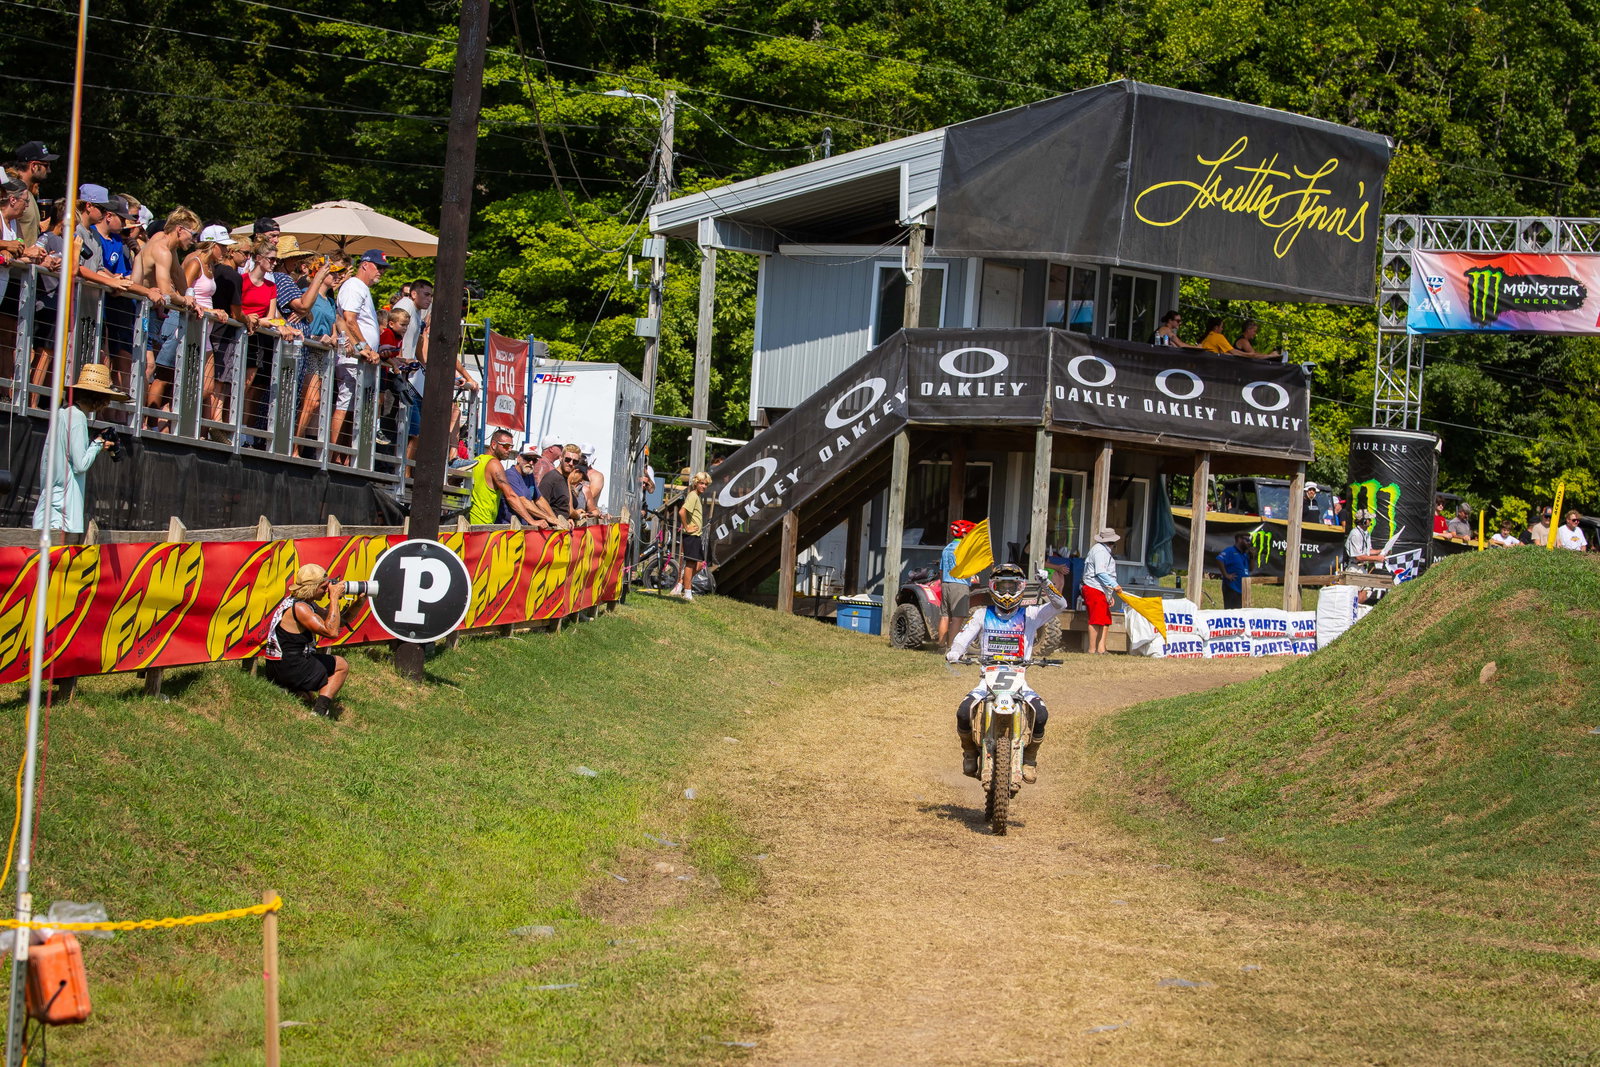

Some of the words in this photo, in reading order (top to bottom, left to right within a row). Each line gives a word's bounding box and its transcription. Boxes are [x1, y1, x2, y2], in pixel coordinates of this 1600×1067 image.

[1134, 136, 1291, 227] Loretta
[1503, 282, 1580, 297] MONSTER
[921, 382, 1026, 396] OAKLEY
[1055, 385, 1128, 409] OAKLEY
[1143, 399, 1216, 421] OAKLEY
[1231, 410, 1302, 432] OAKLEY
[715, 466, 800, 540] OAKLEY
[819, 387, 908, 463] OAKLEY
[1272, 540, 1320, 553] MOTER
[465, 530, 524, 628] FMF
[102, 541, 202, 672] FMF
[207, 539, 295, 661] FMF
[1207, 617, 1245, 630] PARTS
[1249, 618, 1287, 631] PARTS
[1162, 641, 1203, 655] PARTS
[1209, 641, 1251, 653] PARTS
[1254, 641, 1292, 655] PARTS
[992, 672, 1018, 690] 5
